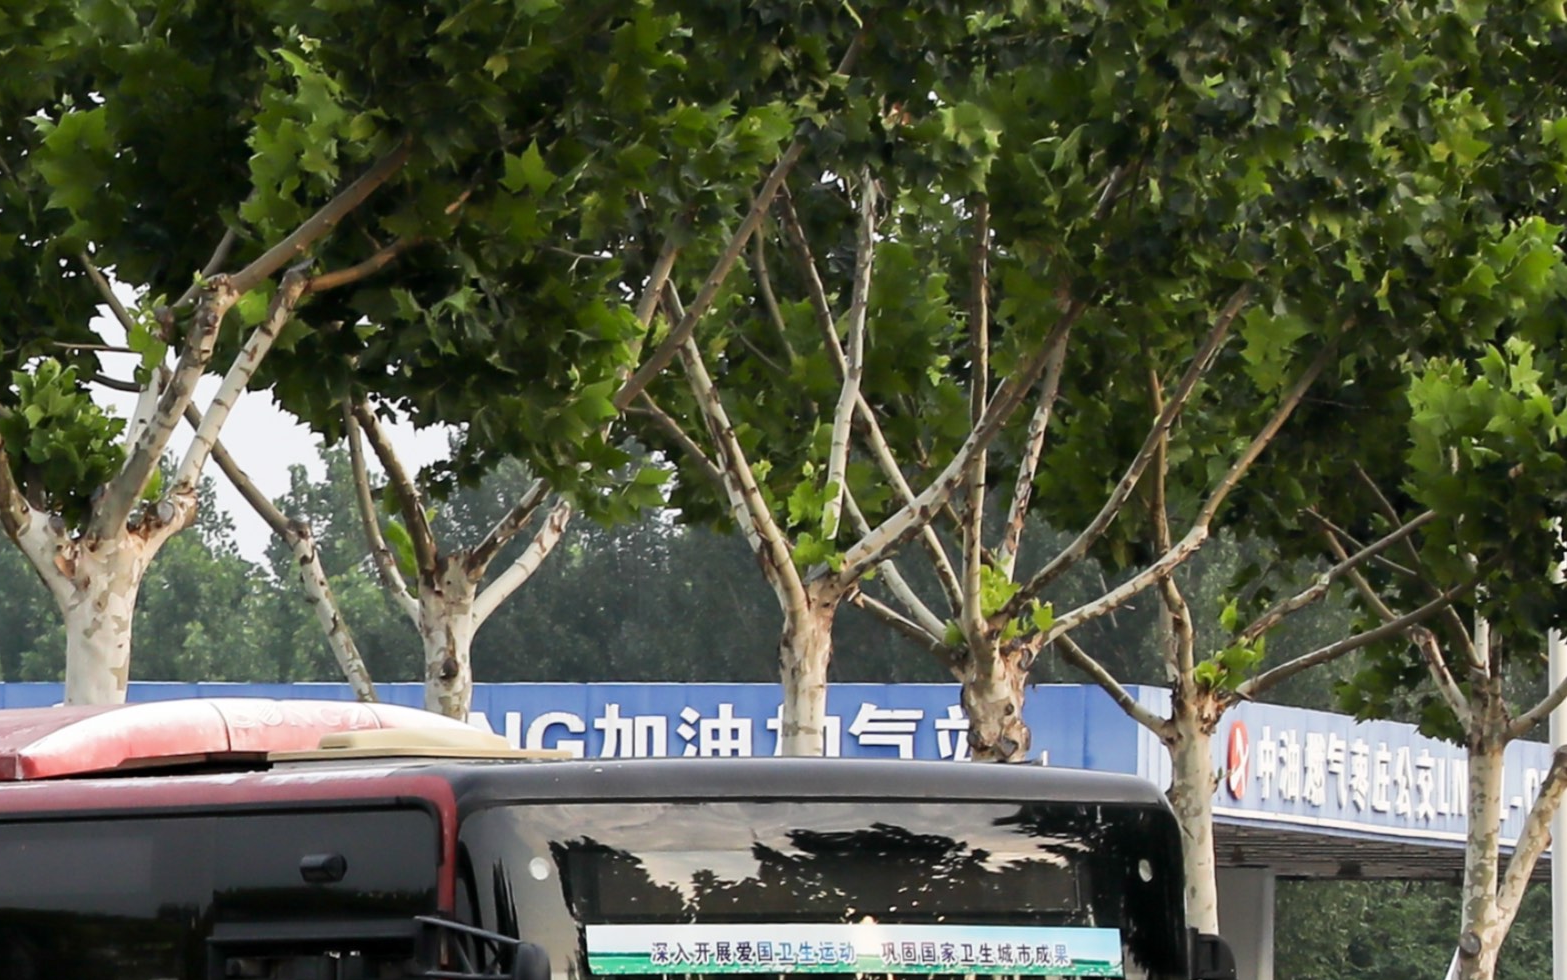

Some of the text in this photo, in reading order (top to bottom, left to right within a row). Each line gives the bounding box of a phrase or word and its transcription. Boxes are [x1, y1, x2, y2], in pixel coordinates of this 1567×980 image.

[651, 941, 1070, 966] 深入开展爱国卫生运动 巩固国家卫生城市成果
